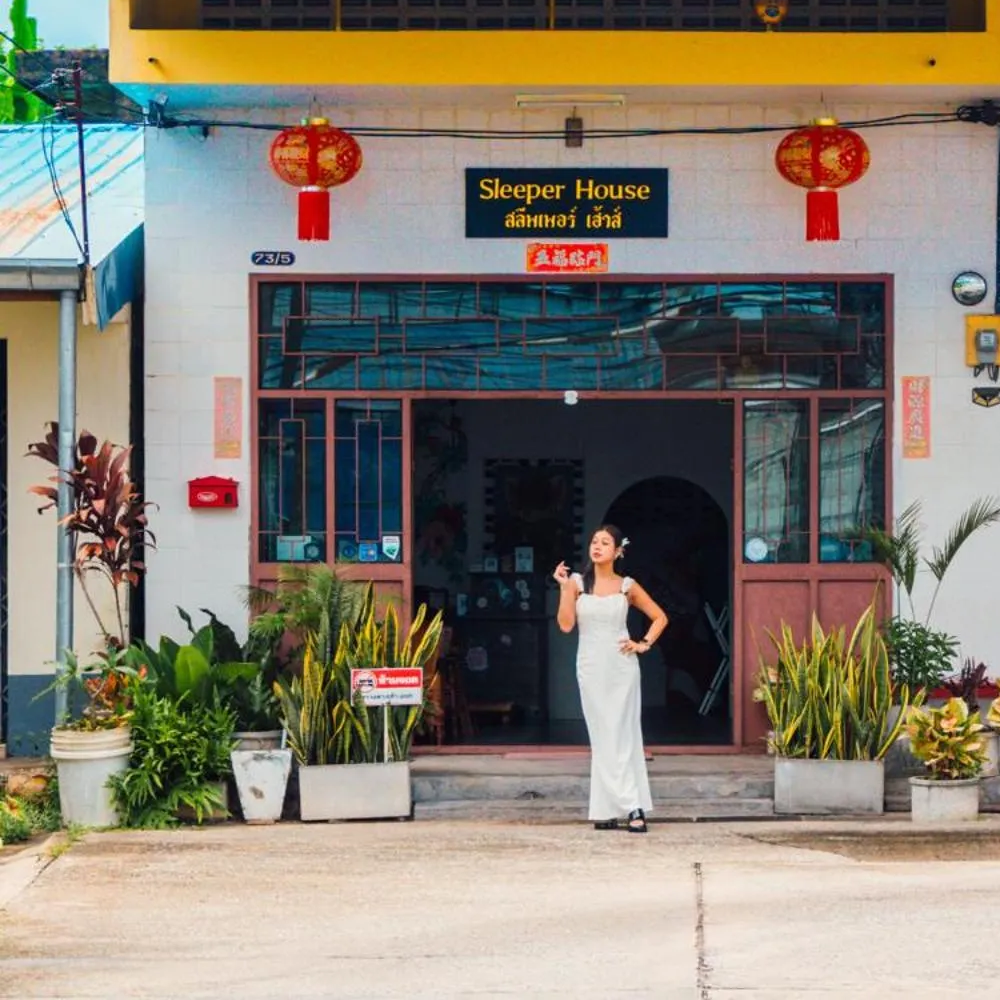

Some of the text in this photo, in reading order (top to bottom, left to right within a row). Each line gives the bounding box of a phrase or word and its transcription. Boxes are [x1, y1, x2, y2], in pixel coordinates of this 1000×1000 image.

[479, 178, 650, 205] Sleeper House
[255, 252, 292, 265] 73/5
